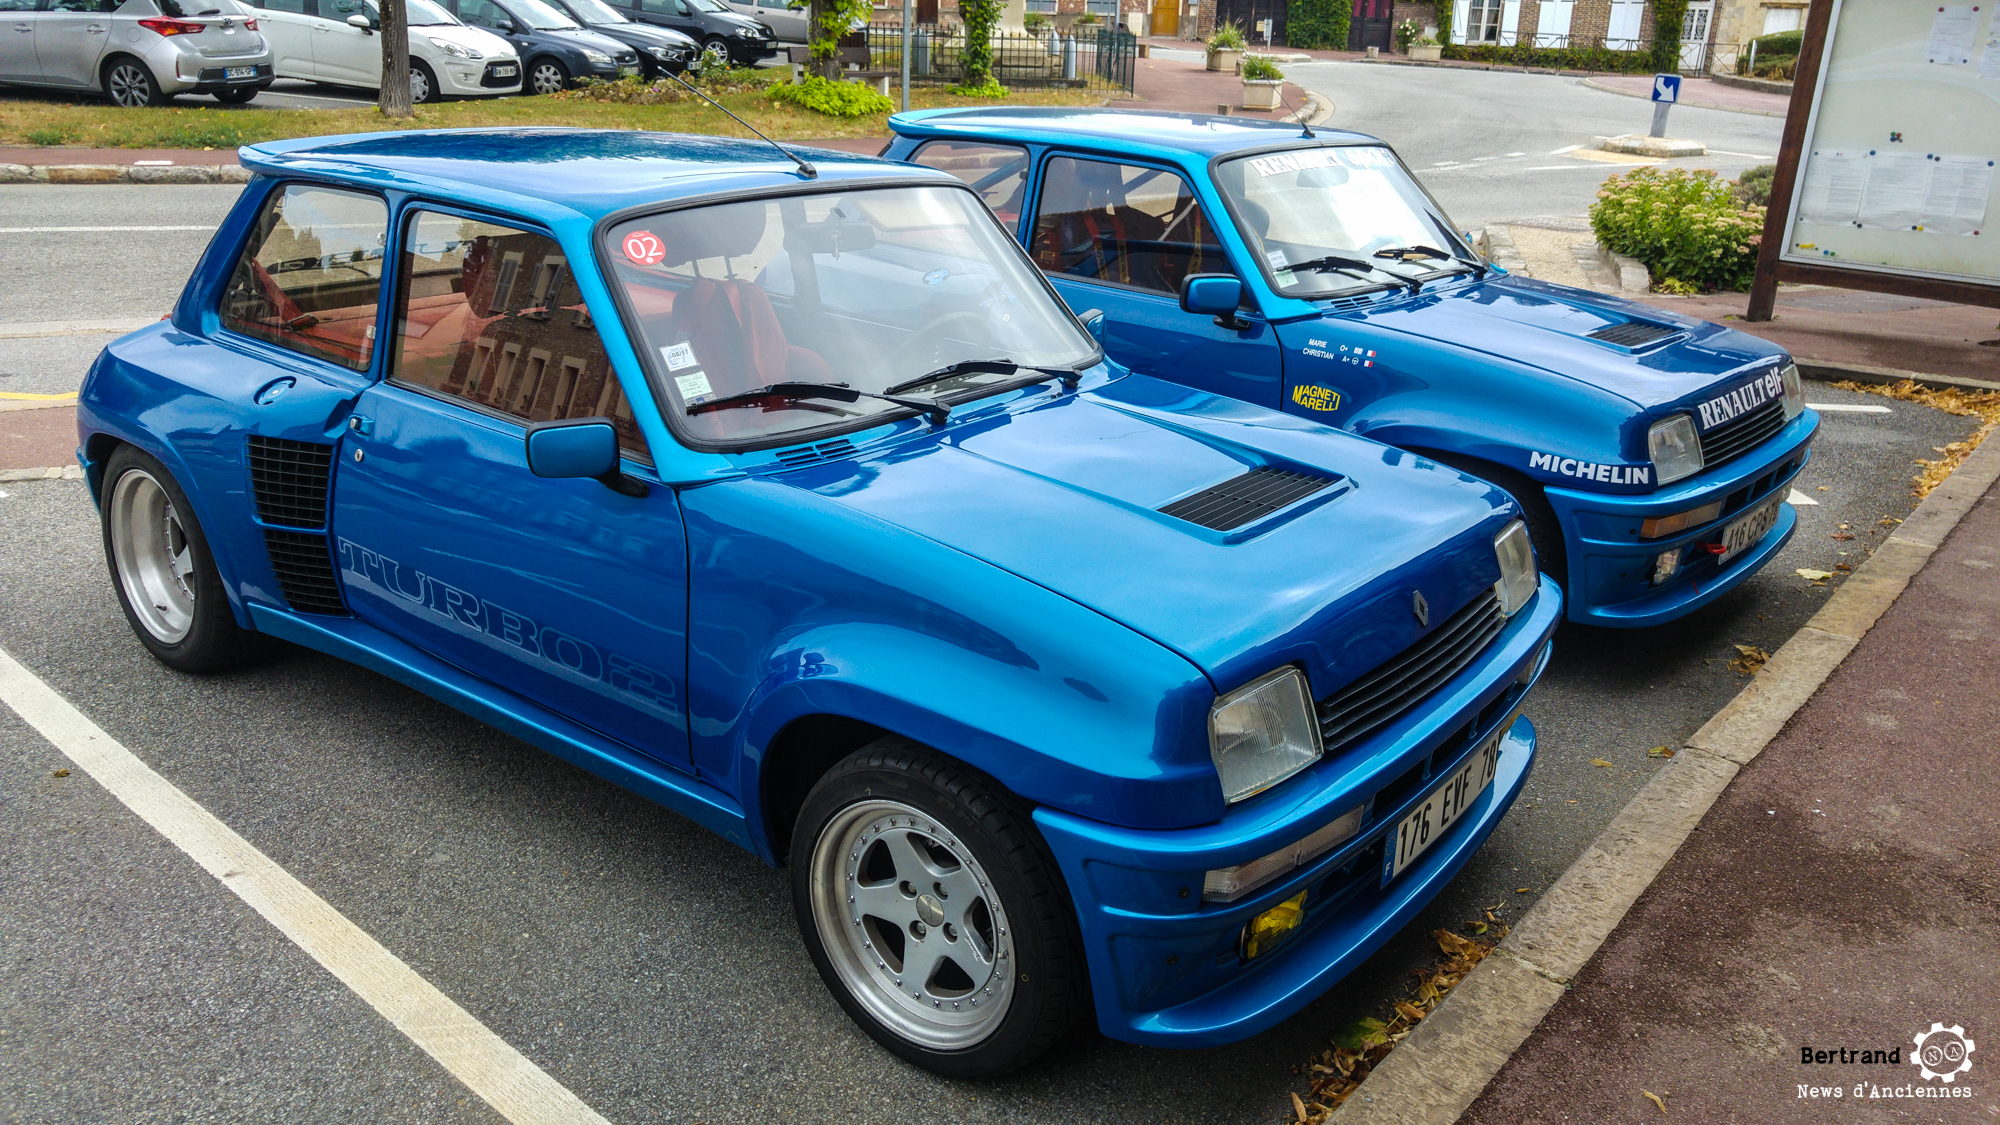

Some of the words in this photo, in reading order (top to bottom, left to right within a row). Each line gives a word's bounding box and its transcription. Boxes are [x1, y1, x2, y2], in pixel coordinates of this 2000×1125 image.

[1248, 150, 1345, 178] RENAULT
[627, 236, 663, 259] 02
[1302, 347, 1335, 360] CHRISTIAN
[1341, 355, 1350, 363] A+
[1308, 338, 1328, 348] MARIE
[1698, 378, 1767, 430] RENAULT
[1765, 366, 1783, 397] elf
[1529, 450, 1649, 485] MICHELIN
[1726, 521, 1747, 554] 416
[1747, 507, 1769, 541] CPS
[1384, 861, 1392, 876] F
[1399, 802, 1432, 866] 176
[1440, 764, 1472, 828] EVF
[1479, 739, 1497, 790] 78
